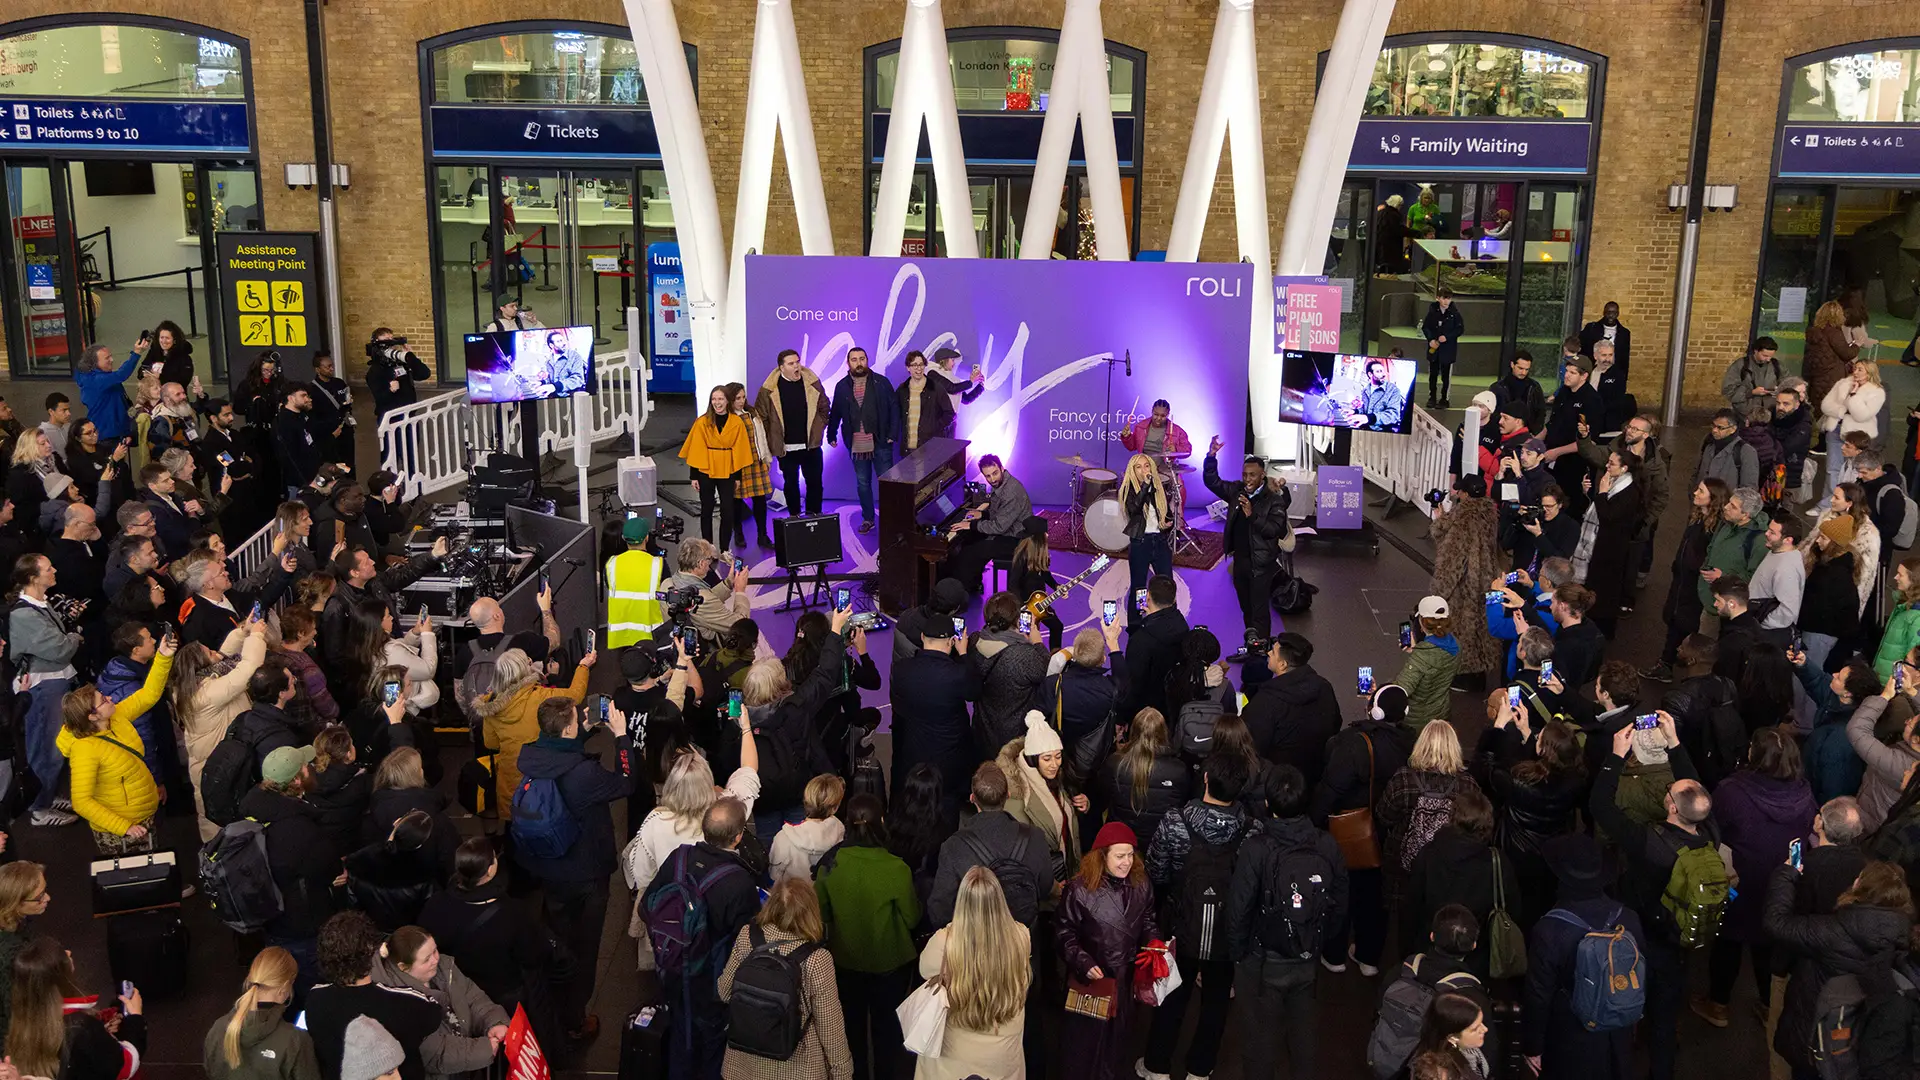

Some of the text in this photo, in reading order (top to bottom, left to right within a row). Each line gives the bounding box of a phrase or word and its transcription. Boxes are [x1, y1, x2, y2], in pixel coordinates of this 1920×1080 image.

[960, 61, 1000, 71] London
[34, 106, 74, 119] Toilets
[37, 126, 139, 140] Platforms 9 to 10
[547, 124, 600, 139] Tickets
[1410, 137, 1528, 157] Family Waiting
[1823, 136, 1857, 147] Toilets
[237, 245, 297, 256] Assistance
[230, 259, 306, 272] Meeting Point
[656, 276, 680, 286] lumo
[1289, 293, 1318, 309] FREE
[776, 306, 859, 322] Come and
[1289, 311, 1323, 327] PIANO
[1049, 408, 1146, 427] Fancy a free
[1048, 427, 1093, 443] piano
